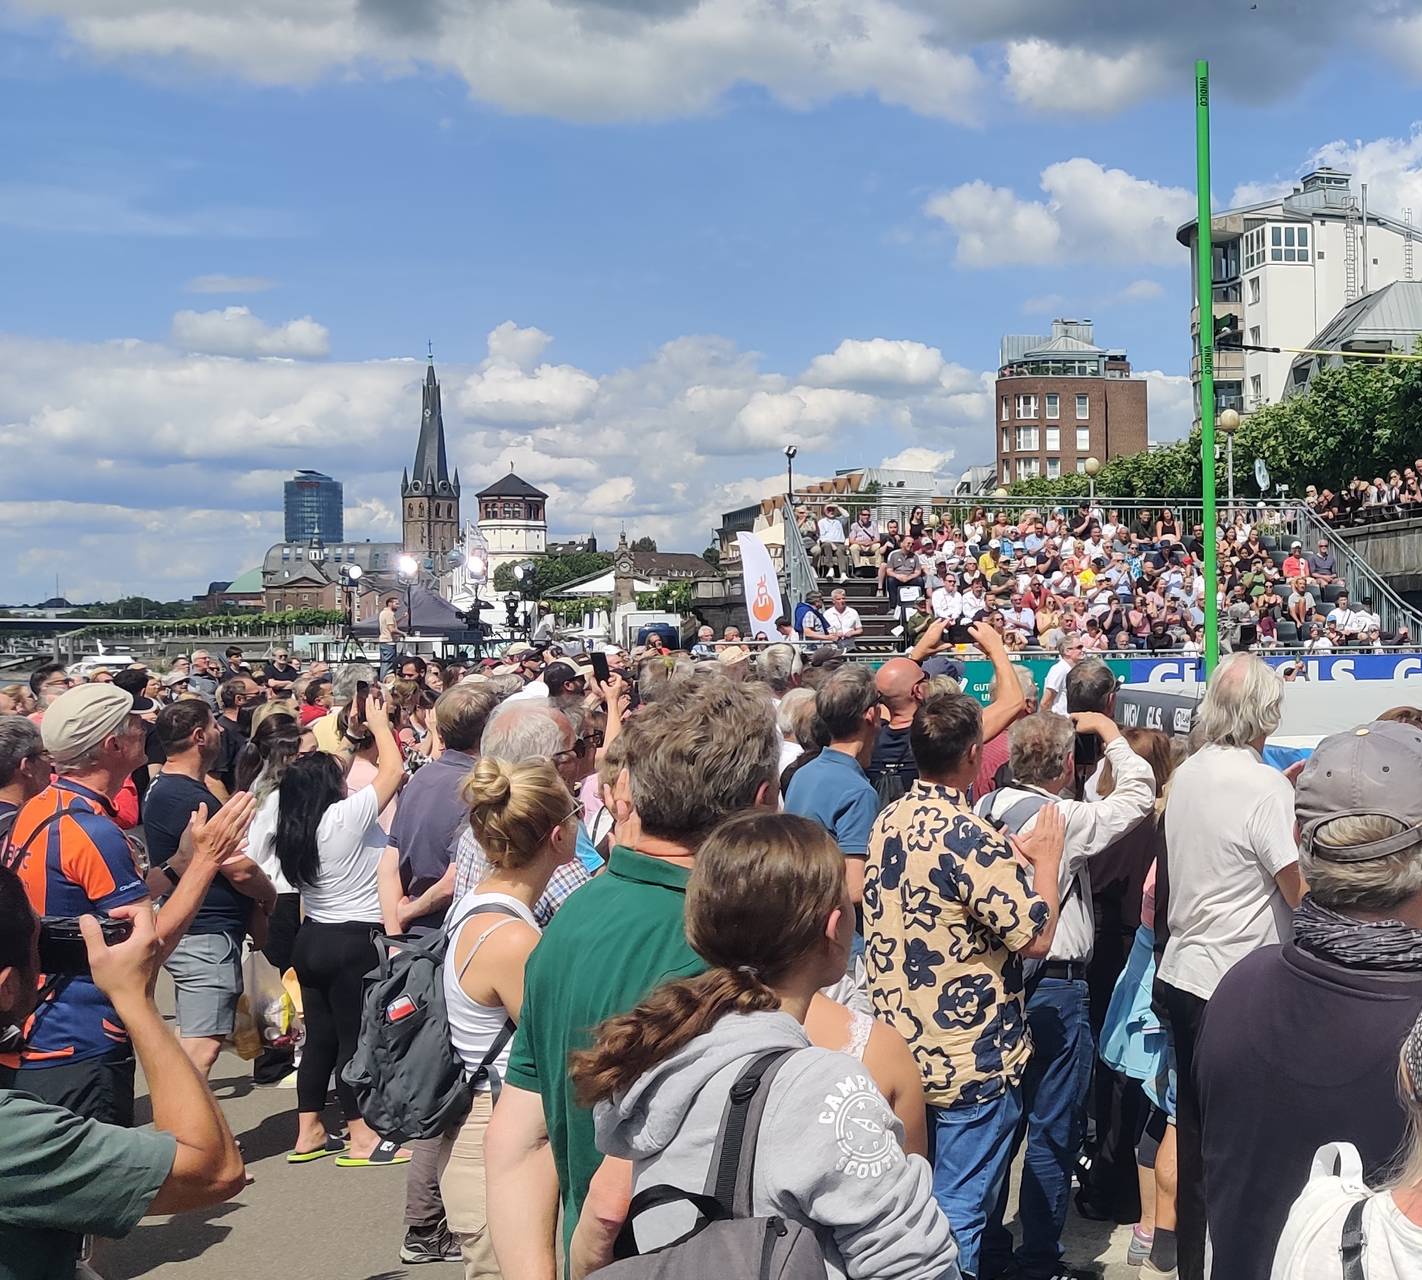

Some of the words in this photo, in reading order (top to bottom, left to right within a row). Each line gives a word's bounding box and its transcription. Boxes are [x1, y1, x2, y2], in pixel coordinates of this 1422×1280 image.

[1199, 76, 1208, 107] VINDICO
[1203, 345, 1213, 375] VINDICO
[818, 1074, 879, 1124] CAMPU
